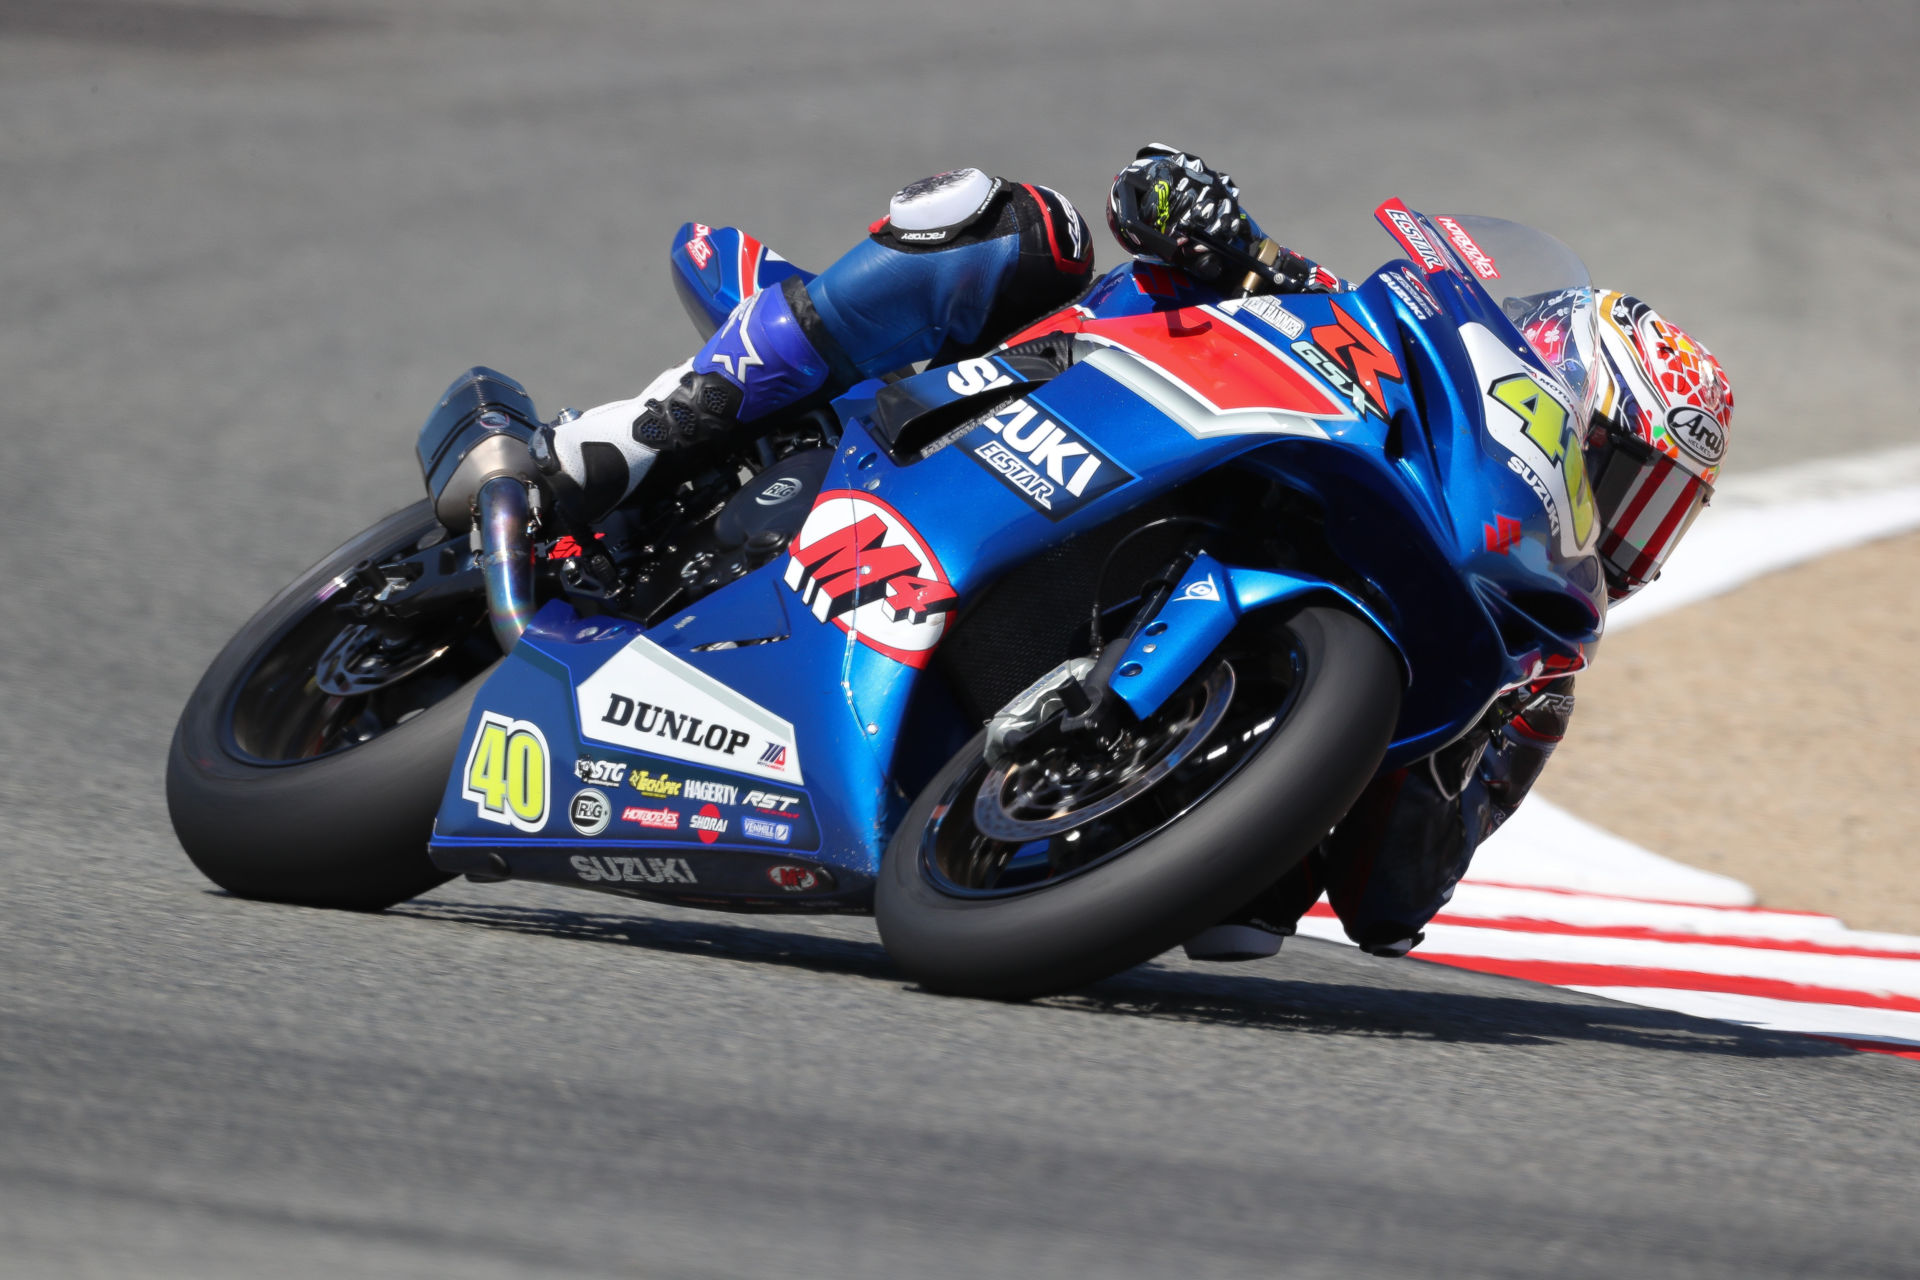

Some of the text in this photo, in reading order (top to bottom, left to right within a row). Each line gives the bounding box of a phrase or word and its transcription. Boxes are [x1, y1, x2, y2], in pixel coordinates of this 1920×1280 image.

[1384, 208, 1444, 270] ECSTAR
[1378, 273, 1427, 320] SUZUKI
[1670, 413, 1723, 454] Arai
[974, 440, 1053, 511] ECSTAR
[1507, 455, 1561, 537] SUZUKI
[783, 513, 958, 625] M4
[601, 693, 751, 755] DUNLOP
[464, 713, 549, 830] 40
[591, 760, 627, 782] STG
[683, 779, 739, 806] HAGERTY
[689, 815, 729, 833] SHORAI
[741, 790, 800, 812] RST
[569, 855, 698, 884] SUZUKI
